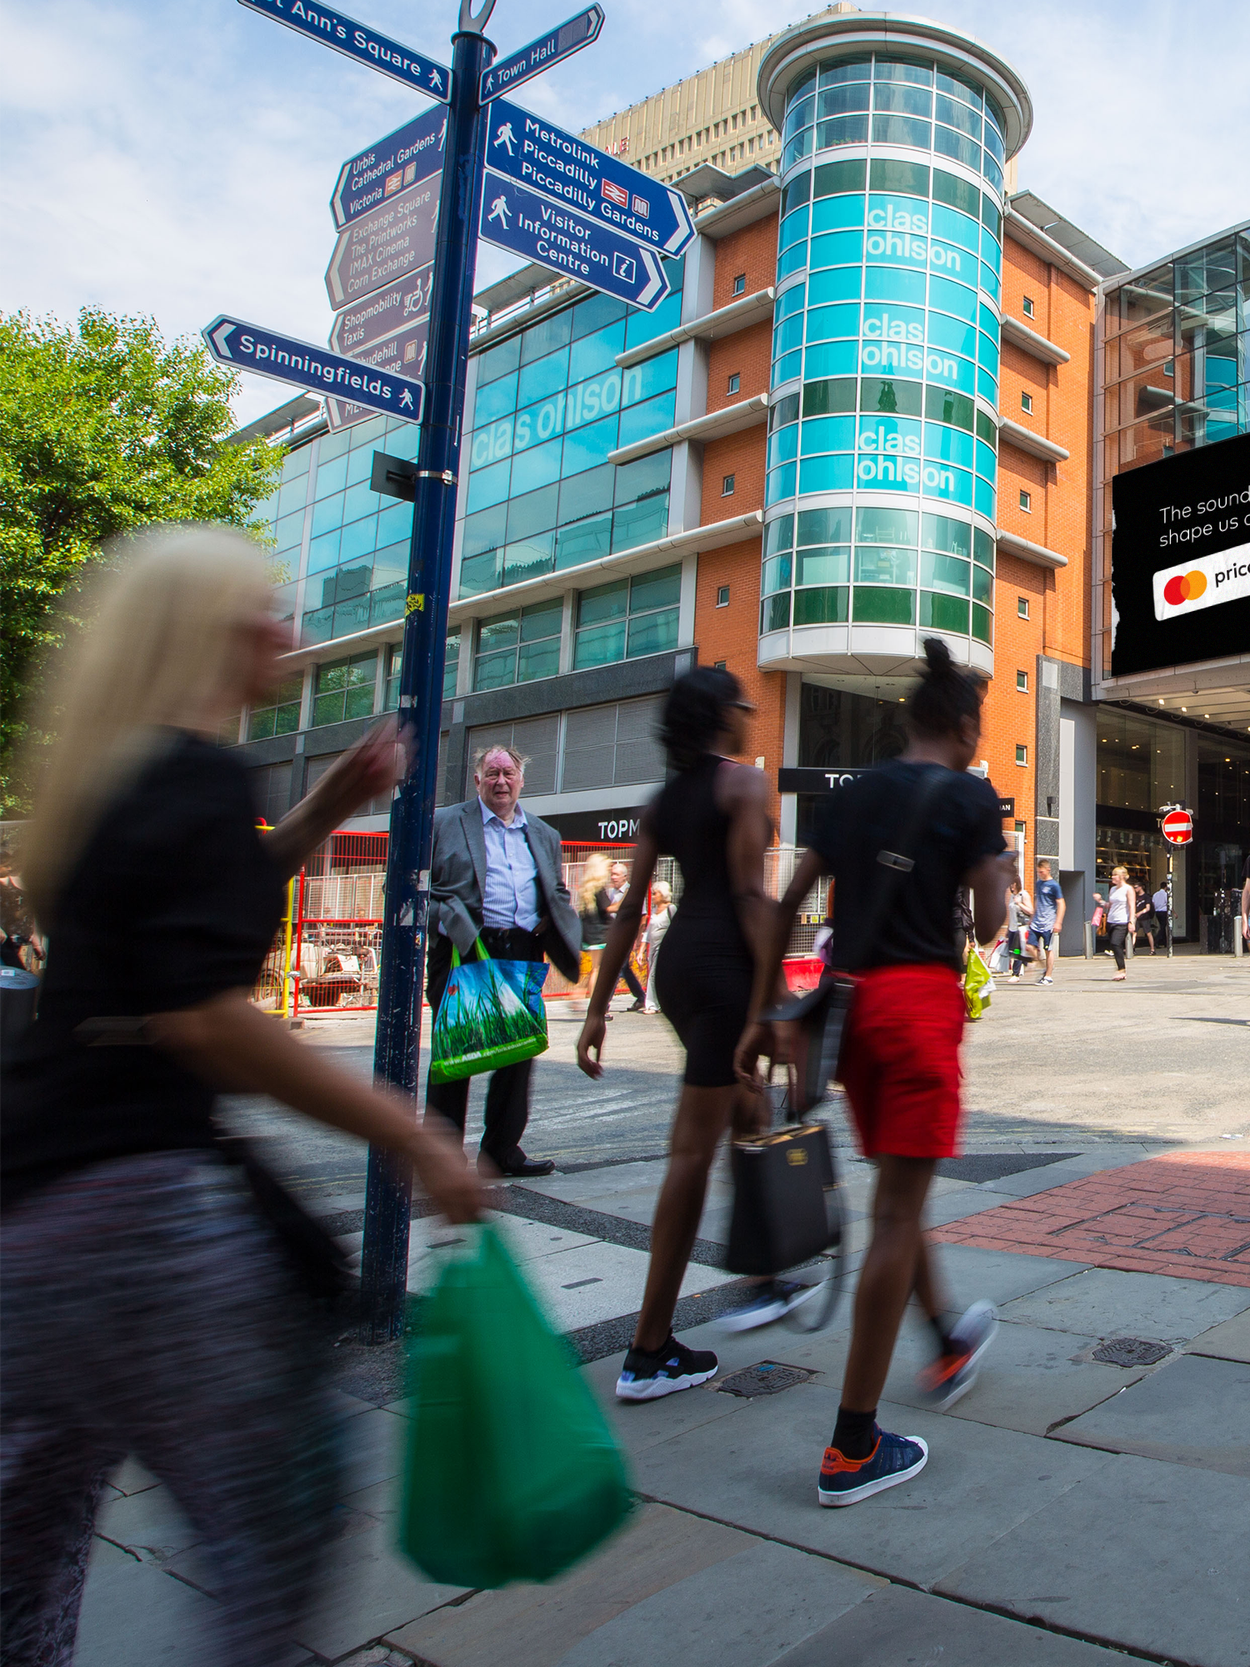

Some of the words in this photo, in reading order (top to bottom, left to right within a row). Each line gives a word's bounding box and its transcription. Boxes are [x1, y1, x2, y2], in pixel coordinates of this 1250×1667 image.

[291, 1, 347, 39] Ann's
[353, 30, 421, 76] Square
[497, 60, 527, 85] Town
[530, 39, 556, 66] Hall
[351, 155, 395, 191] Cathedral
[397, 133, 436, 163] Gardens
[525, 118, 600, 169] Metrolink
[353, 153, 376, 175] Urbis
[523, 139, 598, 190] Piccadilly
[350, 188, 383, 214] Victoria
[353, 211, 395, 242] Exchange
[397, 191, 431, 217] Square
[522, 161, 596, 211] Piccadilly
[601, 202, 660, 241] Gardens
[868, 204, 928, 234] clas
[351, 244, 367, 259] The
[369, 215, 418, 249] Printworks
[518, 213, 609, 267] Information
[541, 204, 591, 240] Visitor
[348, 274, 369, 293] Corn
[372, 250, 415, 281] Exchange
[350, 252, 374, 276] IMAX
[376, 236, 410, 262] Cinema
[536, 241, 590, 275] Centre
[867, 232, 961, 272] ohlson
[344, 291, 402, 330] Shopmobility
[863, 313, 924, 342] clas
[343, 327, 365, 347] Taxis
[239, 334, 392, 399] Spinningfields
[862, 342, 958, 380] ohlson
[471, 414, 531, 466] clas
[537, 365, 642, 439] ohlson
[858, 426, 920, 454] clas
[857, 455, 954, 492] ohlson
[1159, 506, 1192, 524] The
[1159, 523, 1213, 547] shape
[1218, 516, 1239, 532] us
